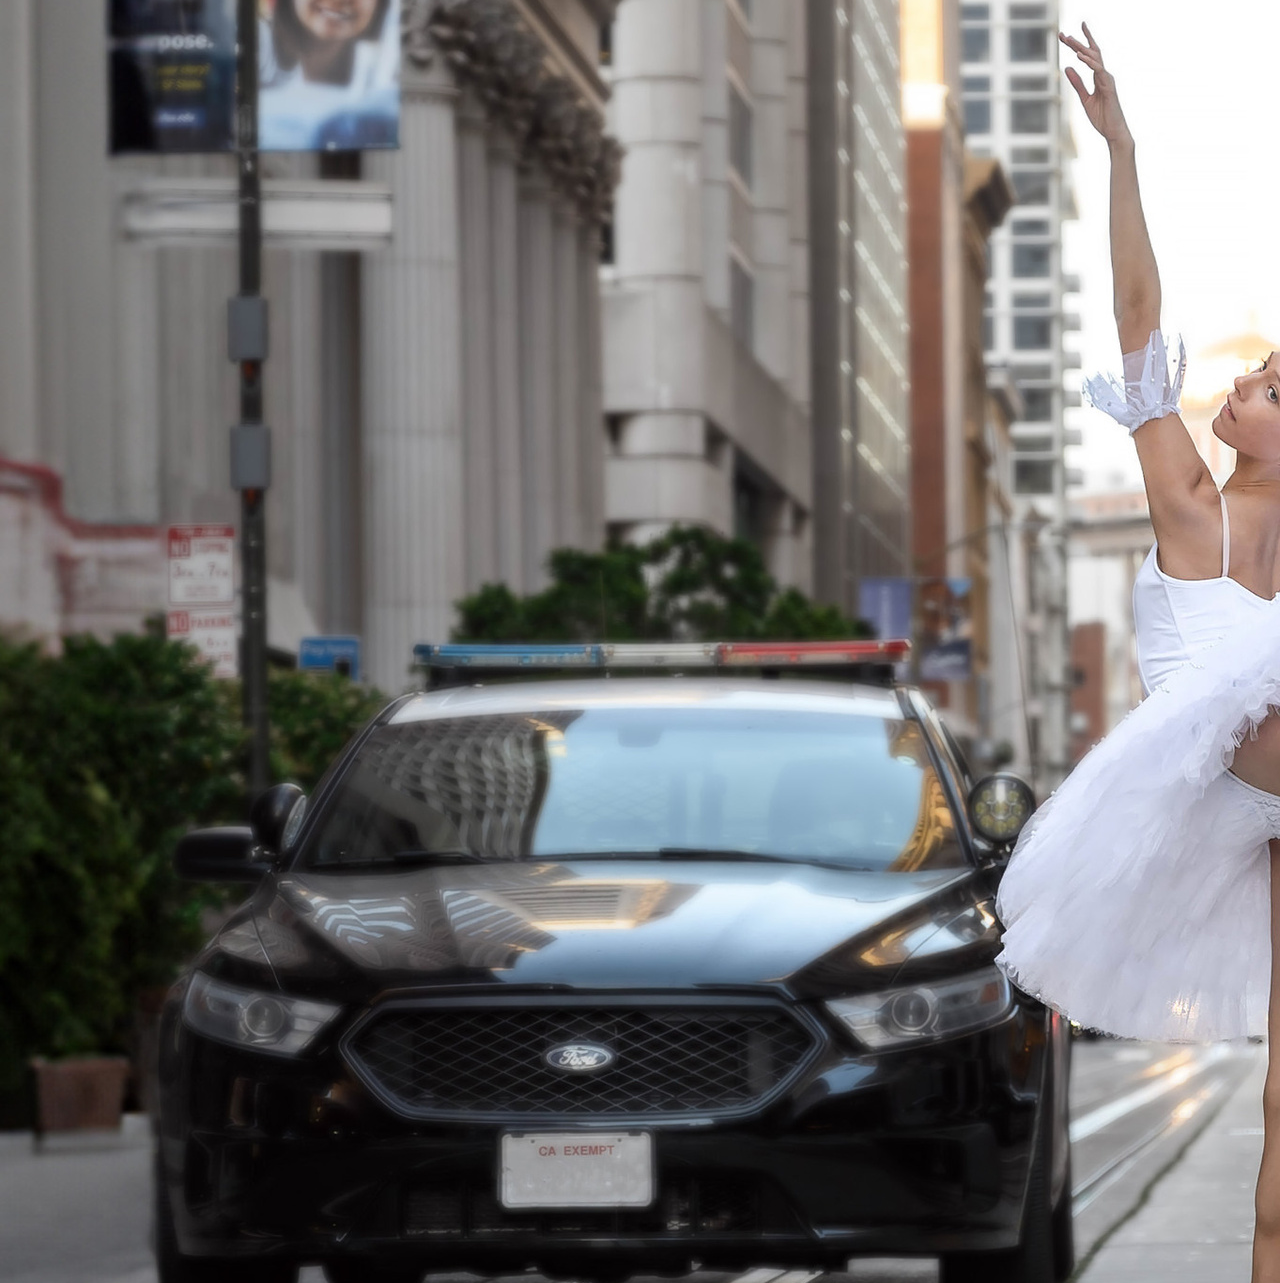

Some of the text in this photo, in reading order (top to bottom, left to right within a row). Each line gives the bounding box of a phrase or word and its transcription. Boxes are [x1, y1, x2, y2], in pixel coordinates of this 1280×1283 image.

[171, 539, 189, 557] NO
[170, 613, 234, 632] NO PARKING
[559, 1049, 600, 1066] Ford
[538, 1144, 616, 1157] CA EXEMPT
